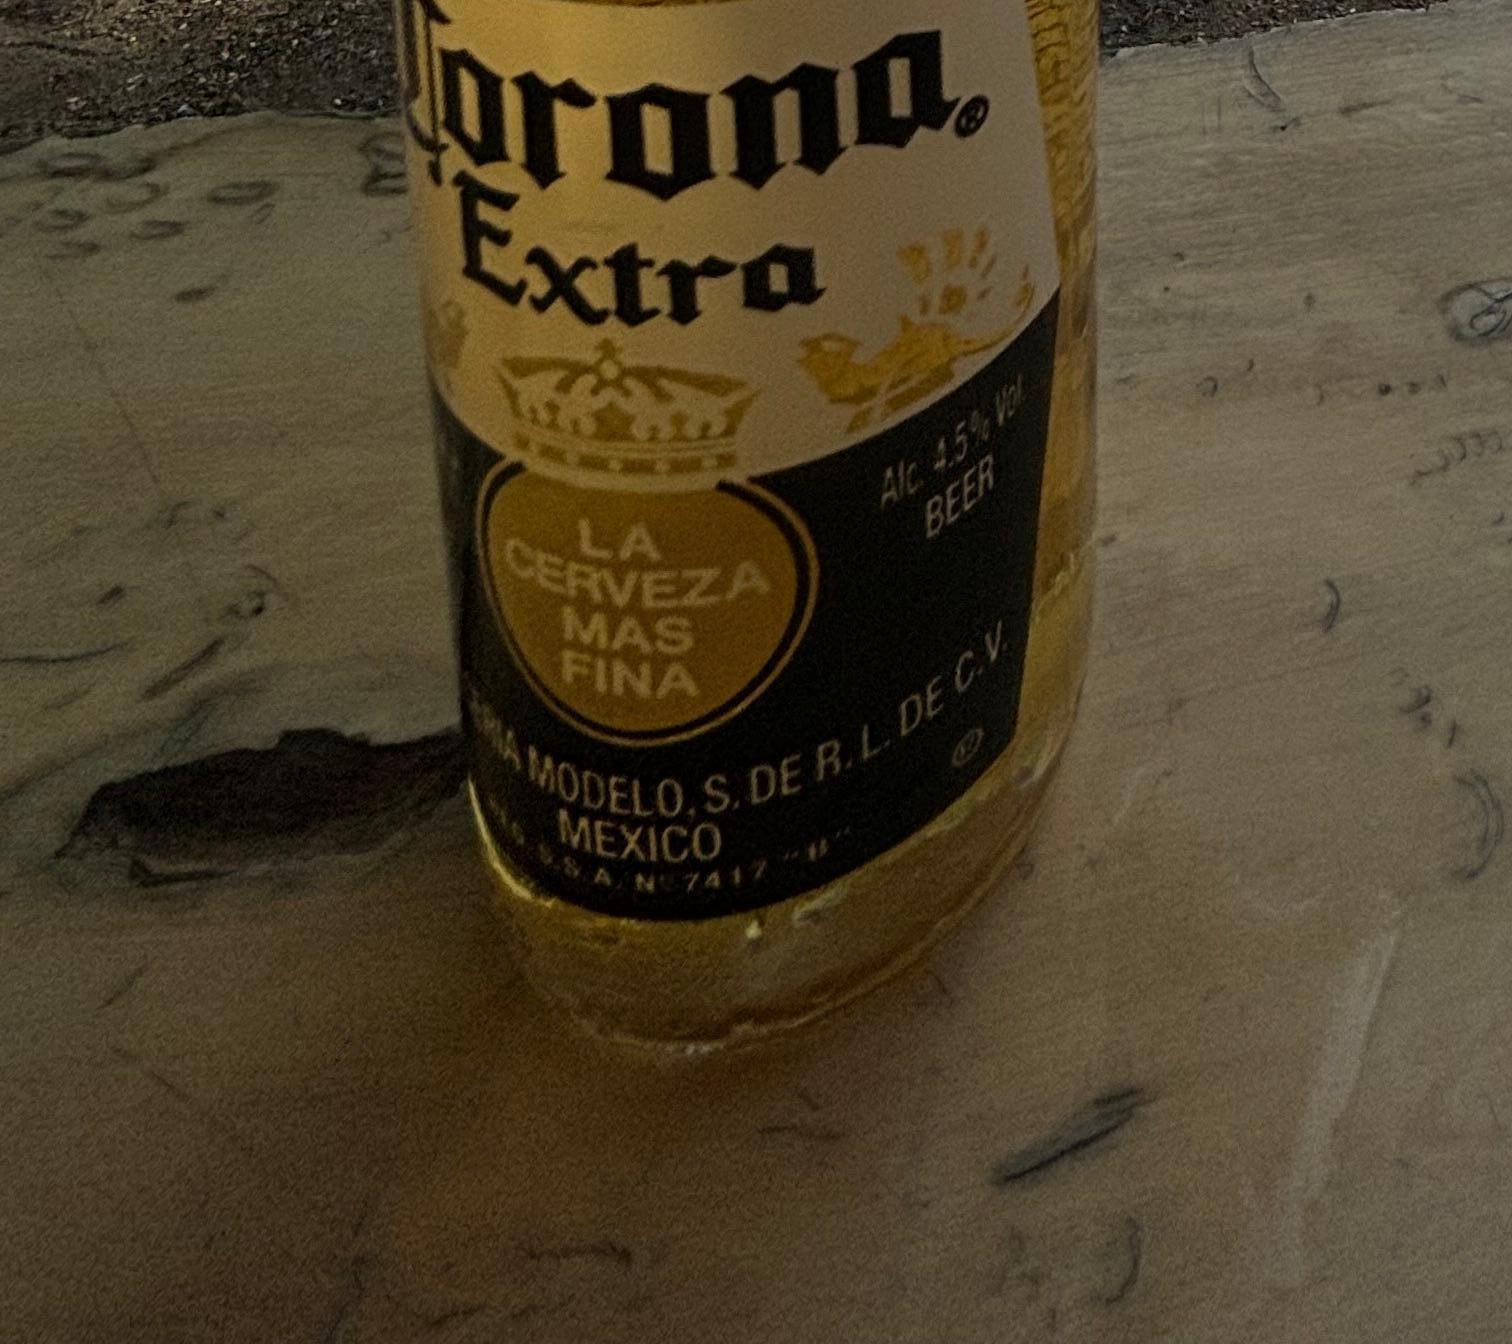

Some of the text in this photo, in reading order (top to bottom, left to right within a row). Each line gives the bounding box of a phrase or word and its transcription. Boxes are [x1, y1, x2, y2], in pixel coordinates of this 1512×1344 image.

[453, 170, 827, 326] Extra
[925, 453, 994, 539] BEER
[578, 518, 662, 562] LA
[505, 536, 770, 610] CERVEZA
[561, 606, 695, 654] MAS
[561, 650, 701, 700] FINA
[527, 743, 696, 819] MODELO,
[749, 752, 802, 805] DE
[898, 673, 946, 737] DE
[557, 808, 719, 863] MEXICO
